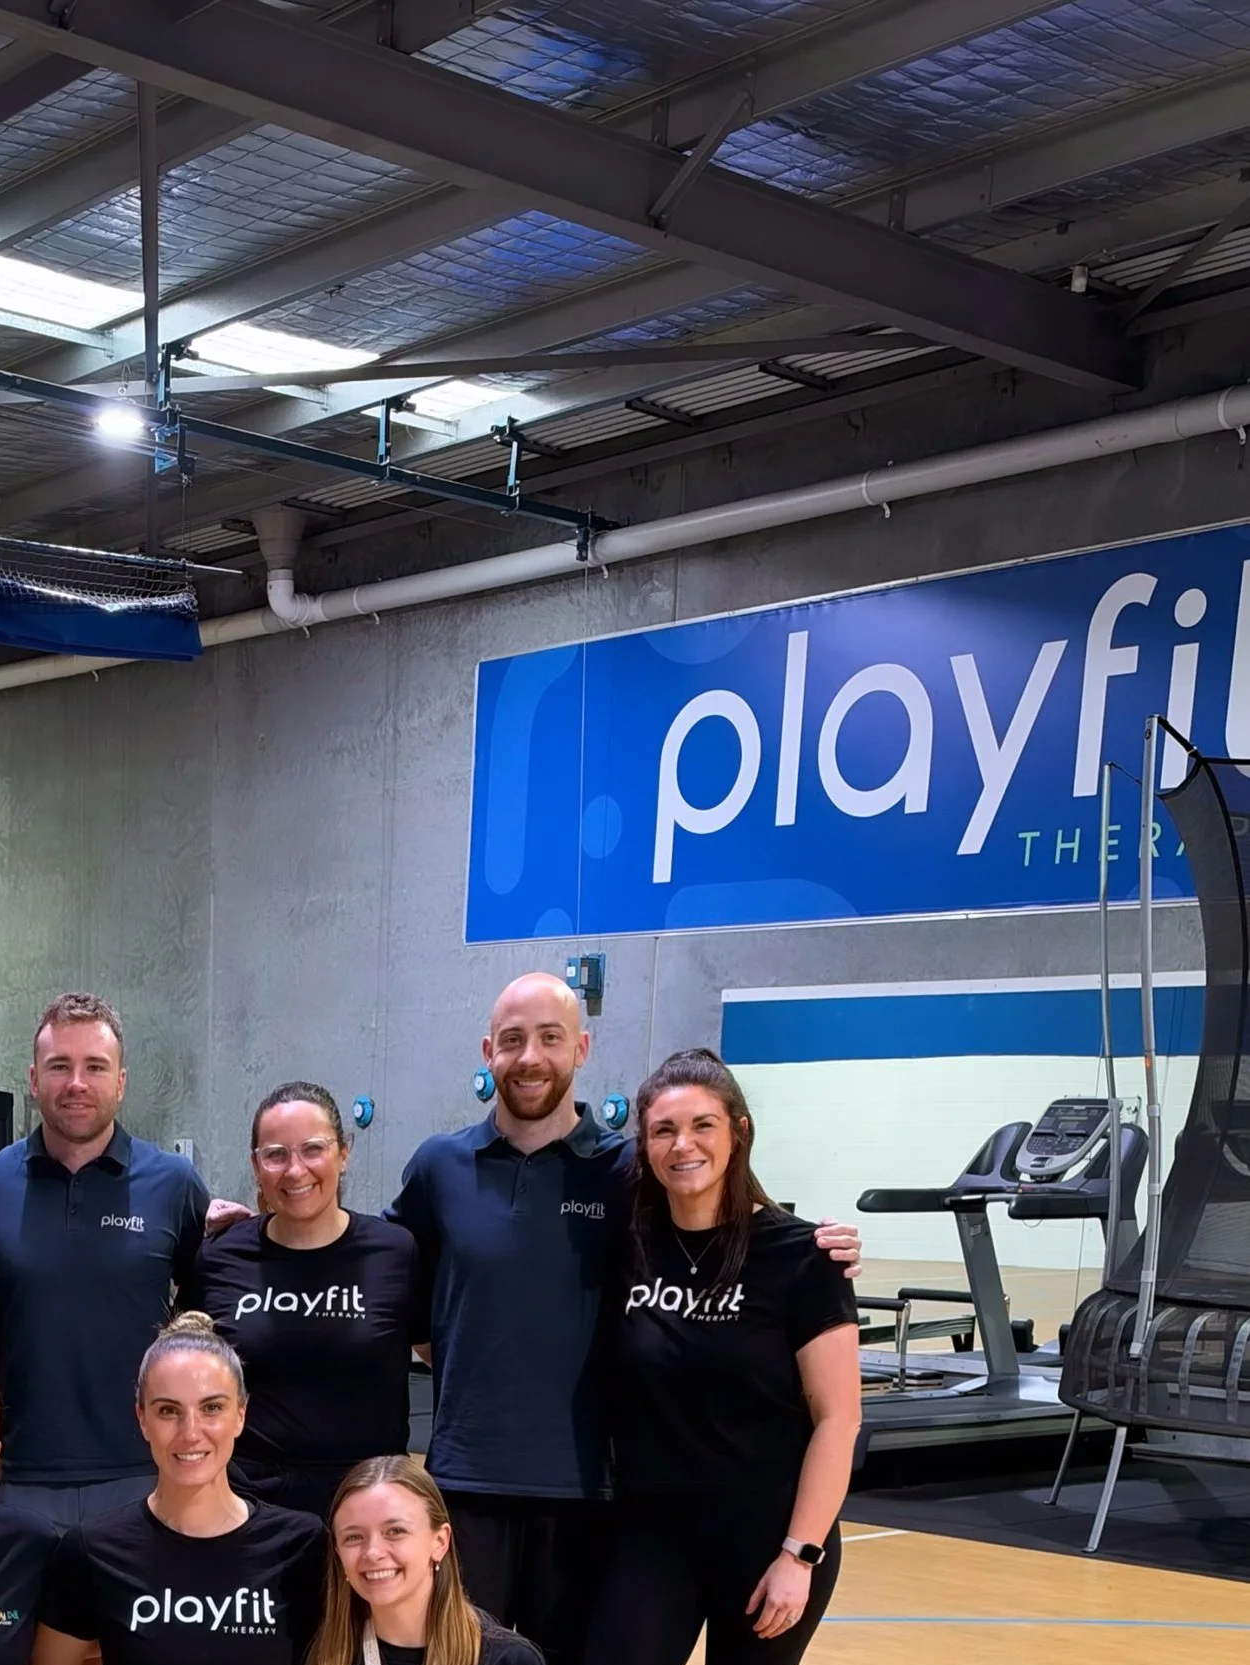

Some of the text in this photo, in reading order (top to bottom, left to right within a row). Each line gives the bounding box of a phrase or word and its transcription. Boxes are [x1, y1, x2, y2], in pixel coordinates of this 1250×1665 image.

[560, 1200, 605, 1216] playfit
[101, 1213, 145, 1230] playfit
[235, 1285, 365, 1320] playfit
[315, 1311, 366, 1320] THERAPY
[691, 1313, 739, 1322] THERAPY
[130, 1587, 276, 1632] playfit
[223, 1626, 276, 1635] THERAPY
